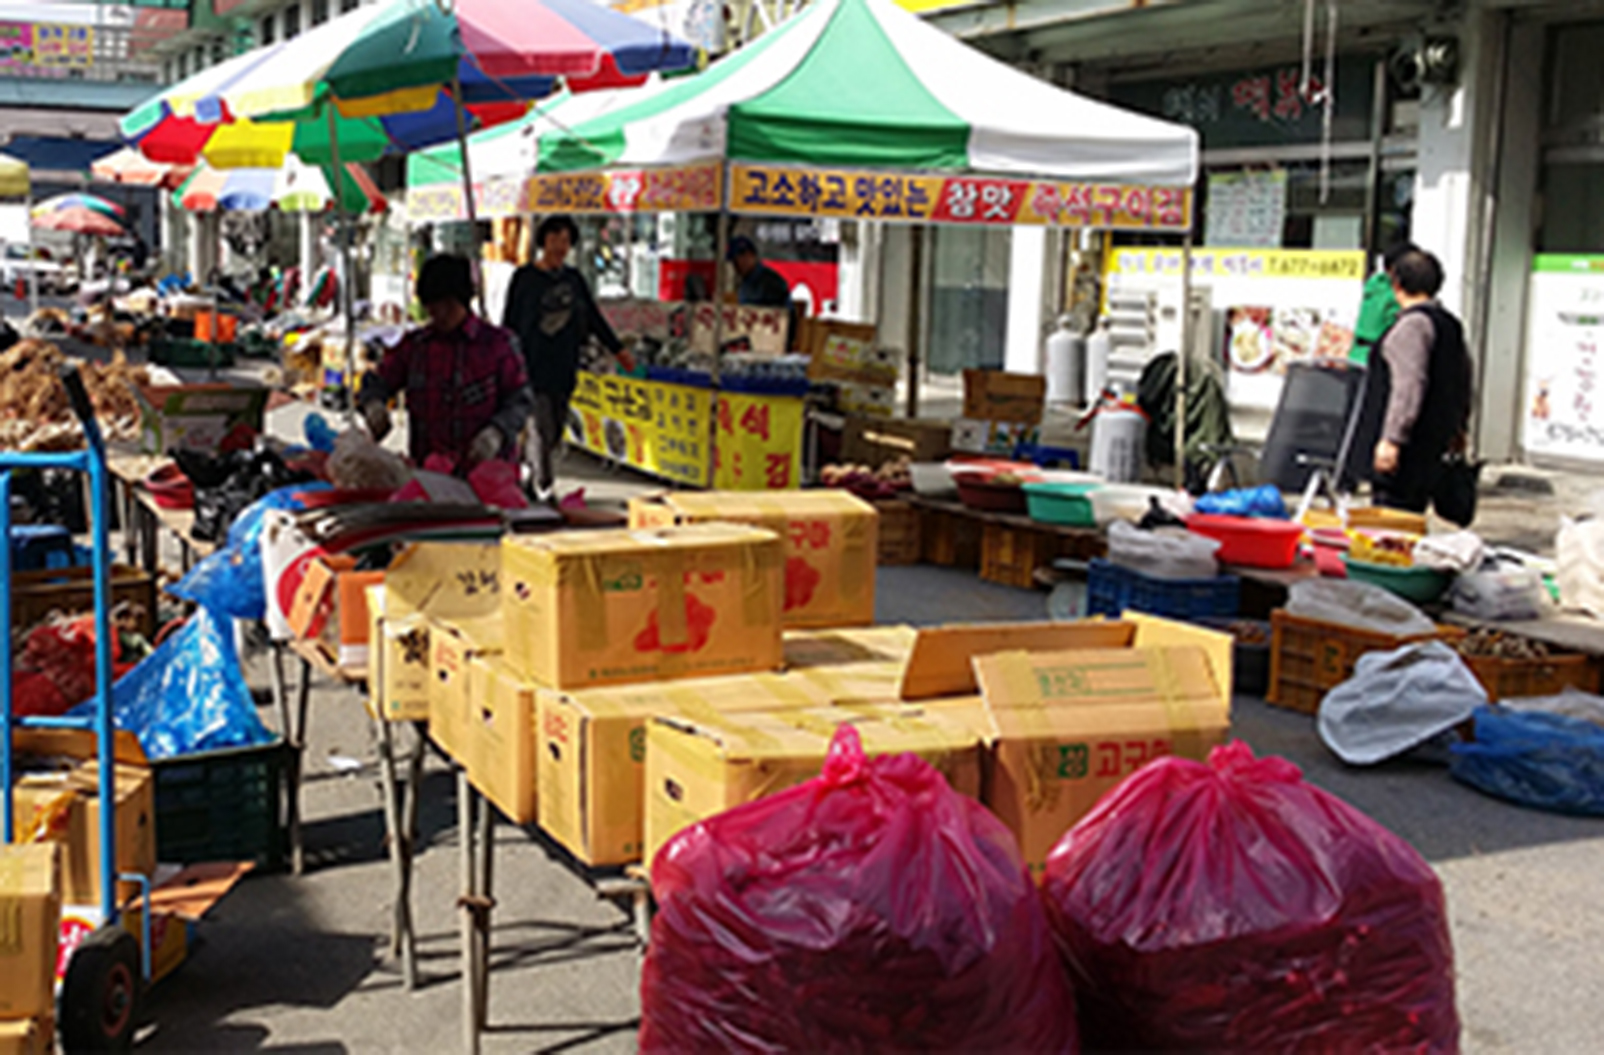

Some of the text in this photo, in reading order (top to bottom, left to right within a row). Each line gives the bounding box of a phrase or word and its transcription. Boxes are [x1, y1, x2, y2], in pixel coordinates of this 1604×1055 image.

[743, 170, 848, 213] 고소하고
[854, 176, 930, 218] 맛있는
[947, 182, 1014, 220] 참맛
